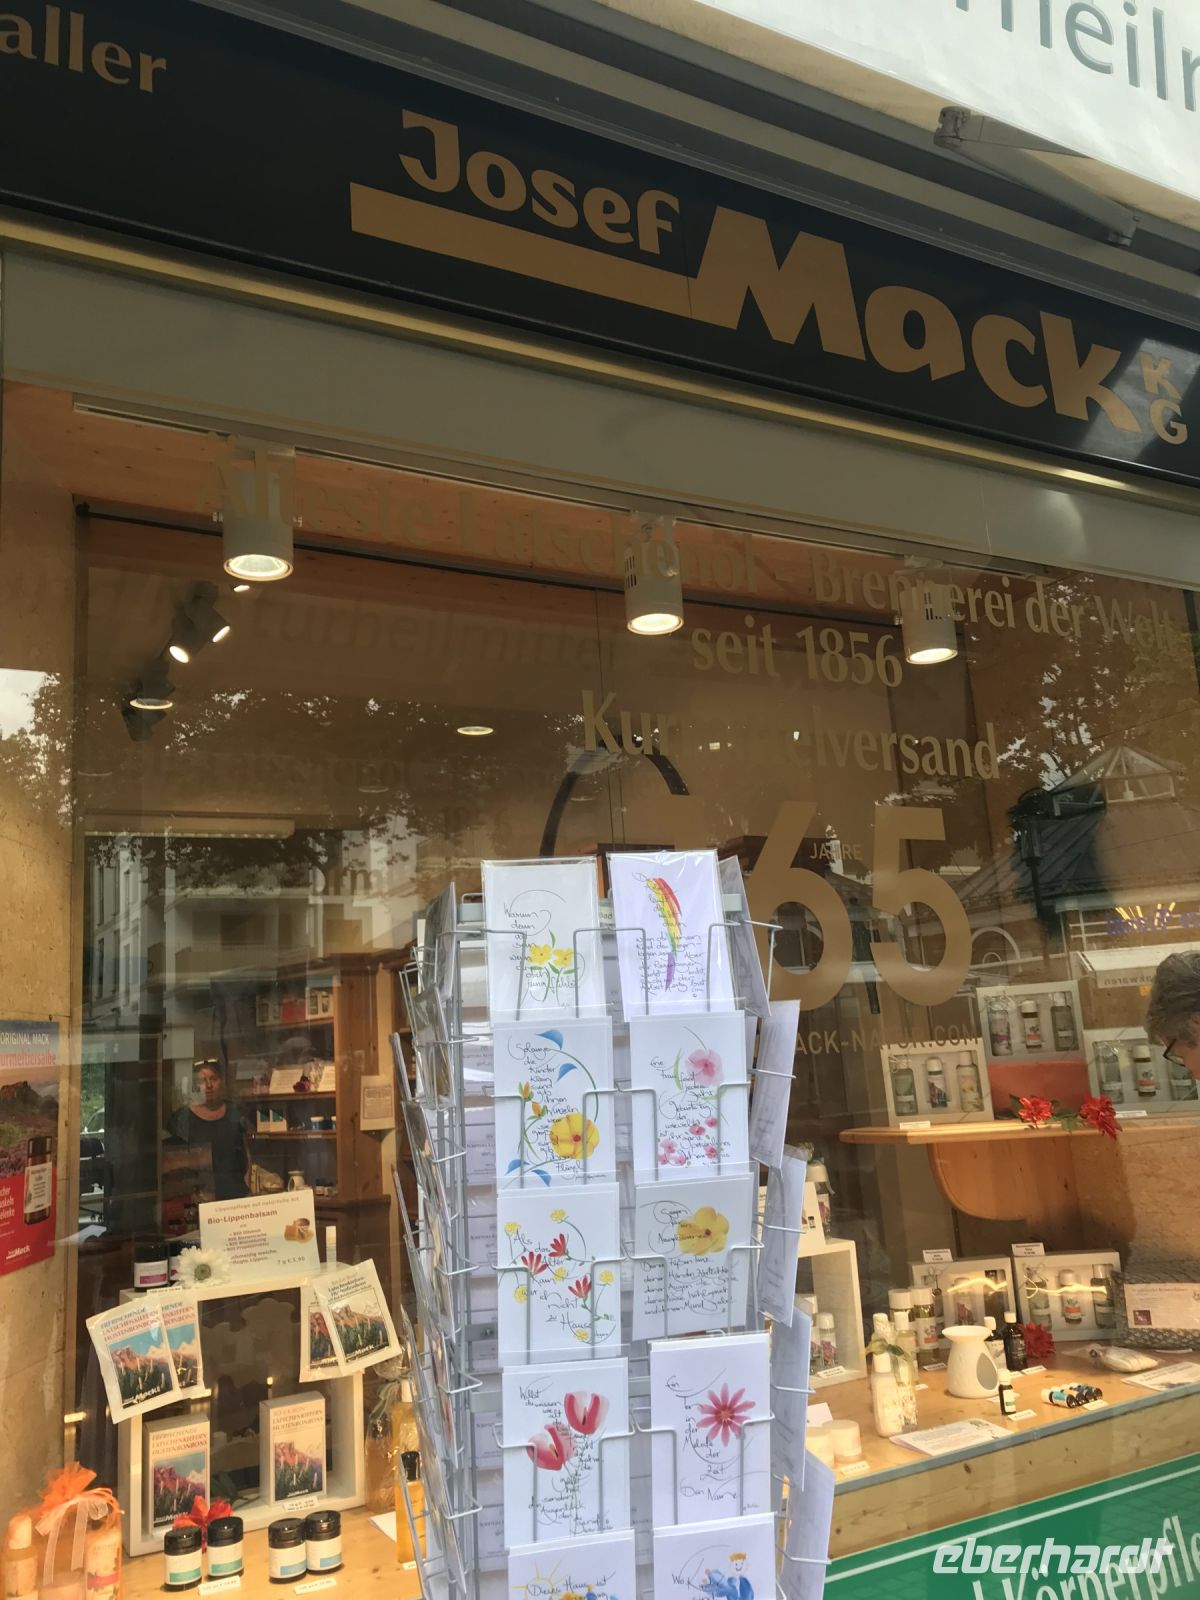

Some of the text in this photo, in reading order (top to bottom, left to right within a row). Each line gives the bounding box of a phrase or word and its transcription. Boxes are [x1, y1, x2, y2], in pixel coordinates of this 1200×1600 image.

[0, 4, 167, 93] aller
[399, 109, 679, 255] Josef
[694, 205, 1142, 433] Mack
[1025, 576, 1084, 638] der
[691, 616, 903, 688] seit 1856
[581, 689, 1001, 780] Kurelversand
[810, 843, 863, 861] JARE
[207, 1209, 278, 1225] Bio-Lippenbalsam
